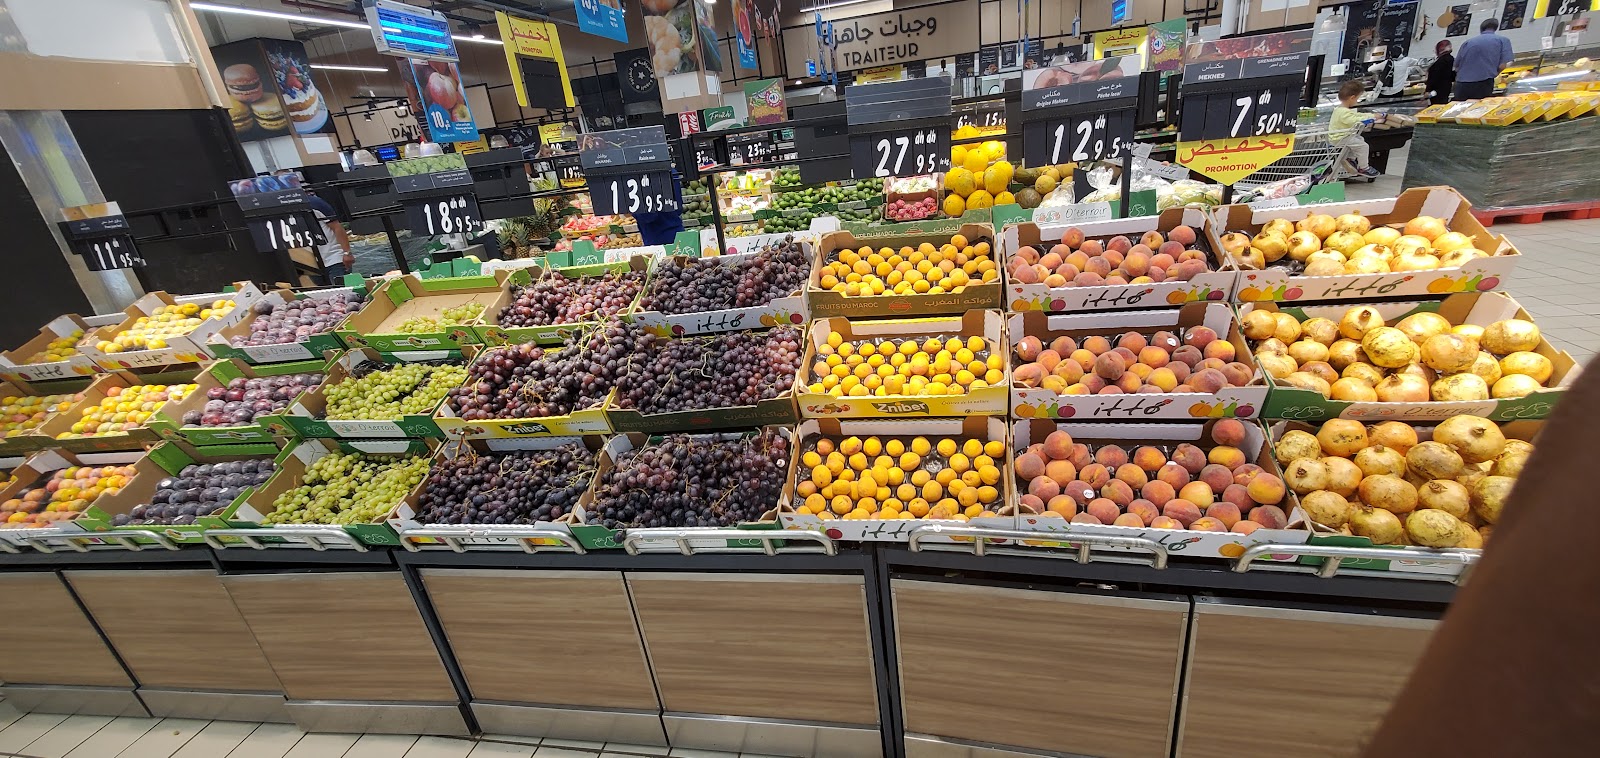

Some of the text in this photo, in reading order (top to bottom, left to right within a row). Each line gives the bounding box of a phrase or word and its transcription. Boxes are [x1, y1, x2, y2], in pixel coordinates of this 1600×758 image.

[879, 14, 938, 38] وجبات
[1102, 30, 1141, 45] تخفيض
[843, 43, 919, 67] TRAITEUR
[1284, 54, 1300, 62] ROUGE
[1198, 73, 1225, 81] MEKNES
[1041, 90, 1061, 100] مكناس
[430, 111, 445, 129] 10
[1230, 96, 1252, 137] 7
[1258, 89, 1272, 105] dh
[1051, 120, 1092, 165] 12
[1094, 114, 1106, 129] dh
[875, 136, 910, 177] 27
[914, 130, 925, 145] dh
[926, 129, 937, 144] dh
[1204, 163, 1258, 173] PROMOTION
[610, 178, 641, 215] 13
[641, 174, 650, 188] dh
[423, 201, 453, 235] 18
[1065, 206, 1108, 219] O'terroir
[265, 218, 295, 250] 14
[93, 242, 118, 270] 11
[924, 296, 993, 307] فواكه المغرب
[877, 401, 926, 413] Zniber
[358, 423, 396, 432] O'terroir
[504, 423, 546, 435] Zniber
[653, 418, 680, 427] MAROC
[861, 523, 913, 539] itt
